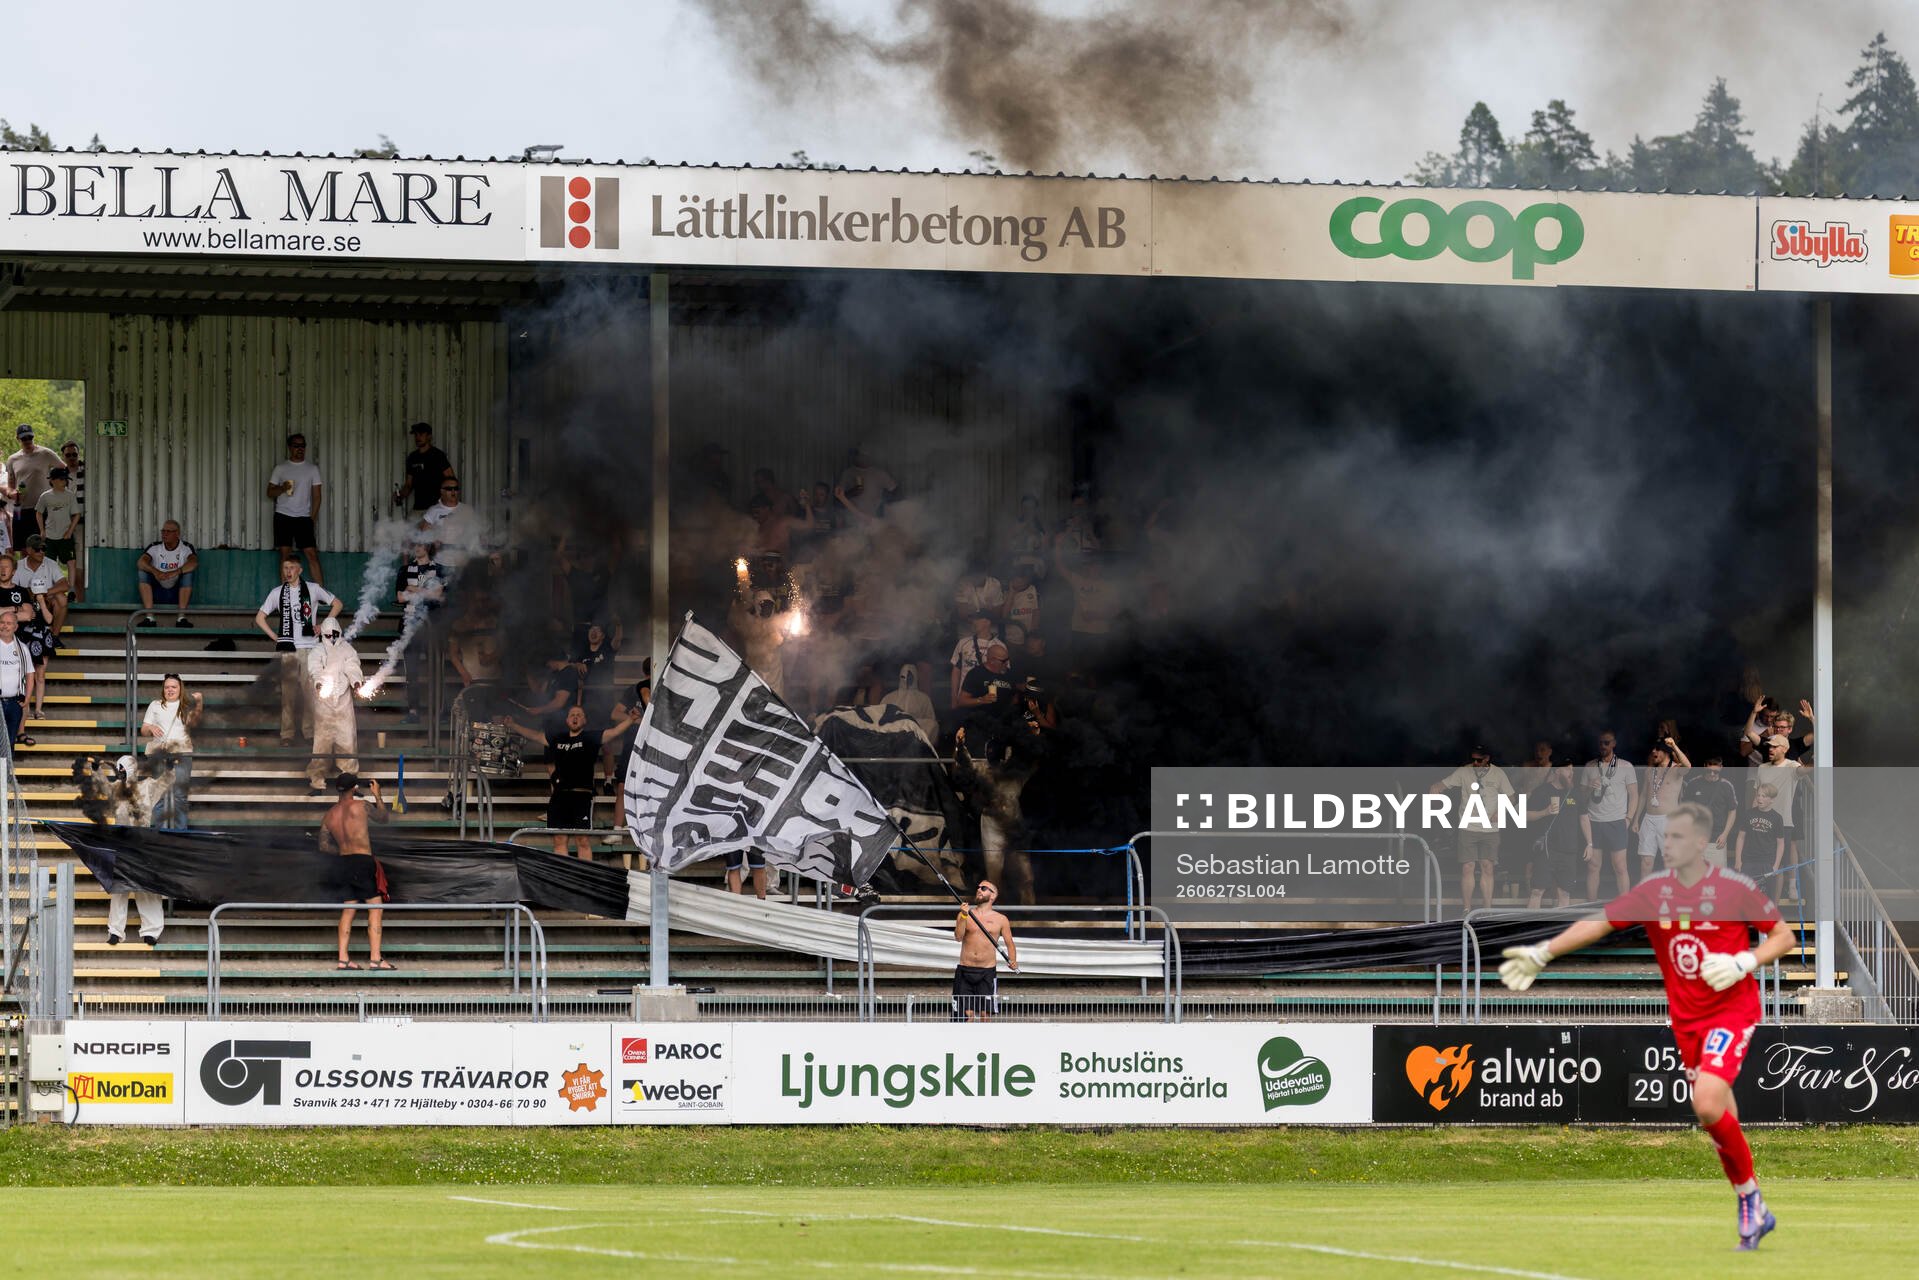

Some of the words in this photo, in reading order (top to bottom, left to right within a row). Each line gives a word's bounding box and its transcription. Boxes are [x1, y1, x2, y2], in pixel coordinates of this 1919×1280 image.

[10, 163, 251, 220] BELLA
[280, 169, 493, 226] MARE
[652, 193, 1047, 262] Lättklinkerbetong
[1058, 206, 1126, 248] AB
[1329, 196, 1584, 280] coop
[143, 228, 361, 252] www.bellamare.se
[1775, 225, 1864, 263] Sibylla
[74, 1043, 170, 1055] NORGIPS
[655, 1043, 722, 1059] PAROC
[1060, 1052, 1183, 1073] Bohusläns
[1481, 1047, 1601, 1083] alwico
[295, 1069, 412, 1088] OLSSONS
[421, 1066, 549, 1089] TRÄVAROR
[568, 1085, 587, 1094] BYGGET
[588, 1082, 598, 1090] ATT
[573, 1078, 579, 1086] VI
[579, 1075, 591, 1085] FÅR
[781, 1052, 1035, 1108] Ljungskile
[1265, 1073, 1323, 1091] Uddevalla
[1758, 1042, 1841, 1090] Far
[1844, 1048, 1911, 1113] &
[97, 1080, 166, 1098] NorDan
[572, 1091, 595, 1100] SNURRA
[642, 1079, 723, 1100] weber
[1060, 1077, 1228, 1101] sommarpärla
[1267, 1090, 1290, 1100] Hjärtat
[1294, 1084, 1325, 1095] Bohuslän
[1480, 1087, 1534, 1107] brand
[1540, 1087, 1563, 1107] ab
[1634, 1079, 1663, 1102] 29
[1673, 1079, 1694, 1103] 0
[293, 1098, 337, 1108] Svanvik
[340, 1098, 360, 1108] 243
[371, 1098, 390, 1108] 471
[394, 1098, 406, 1108] 72
[410, 1098, 457, 1110] Hjälteby
[467, 1099, 513, 1109] 0304-66
[517, 1099, 530, 1109] 70
[533, 1099, 546, 1109] 90
